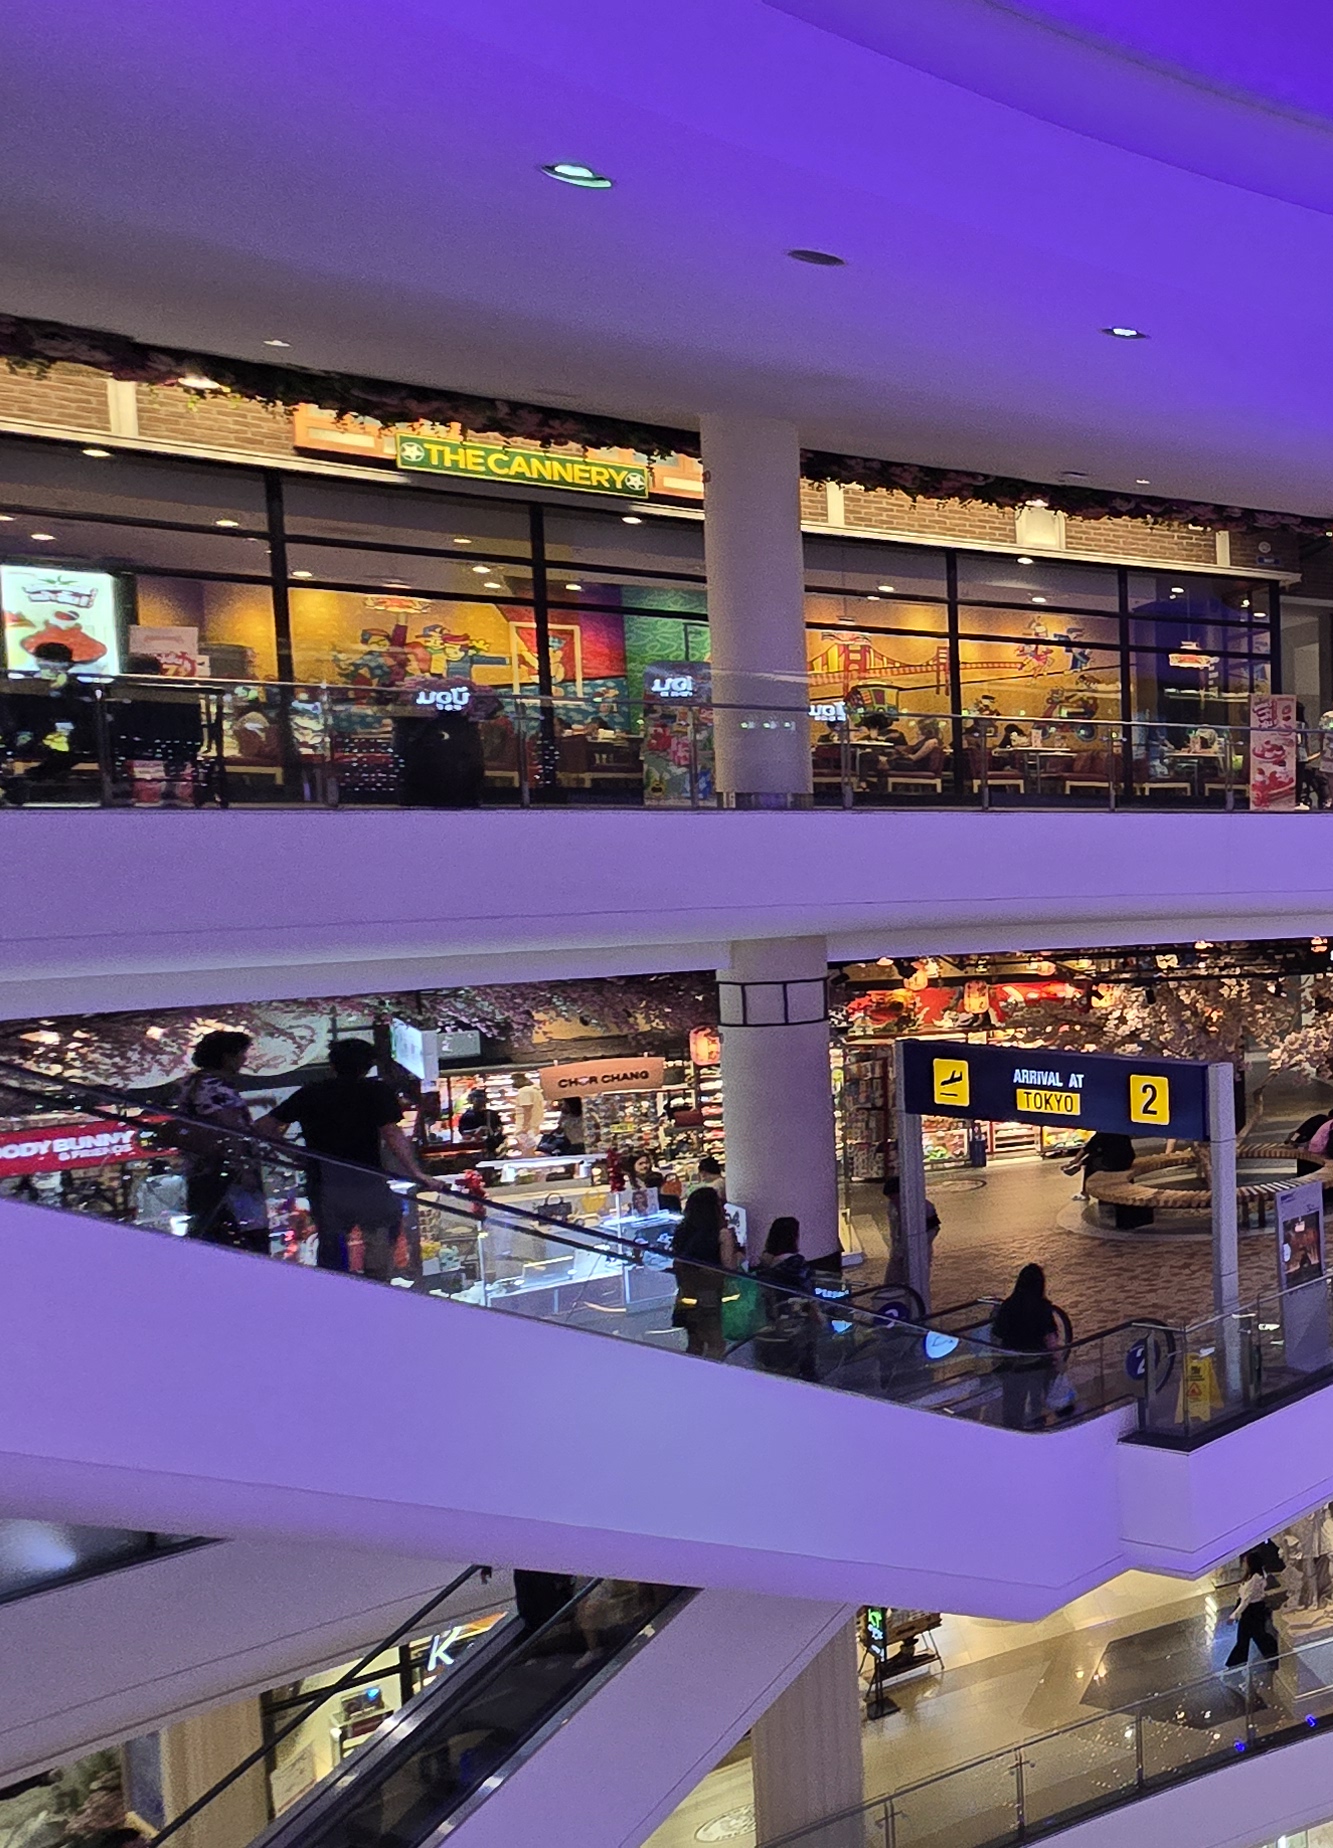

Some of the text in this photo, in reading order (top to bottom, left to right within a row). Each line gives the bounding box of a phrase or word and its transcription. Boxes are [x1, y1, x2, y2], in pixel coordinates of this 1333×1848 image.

[423, 443, 627, 490] THE CANNERY
[601, 1070, 650, 1084] CHANG
[1013, 1069, 1085, 1088] ARRIVAL AT
[1023, 1091, 1074, 1113] TOKYO
[1141, 1083, 1158, 1116] 2
[0, 1130, 136, 1160] ODY BUNNY
